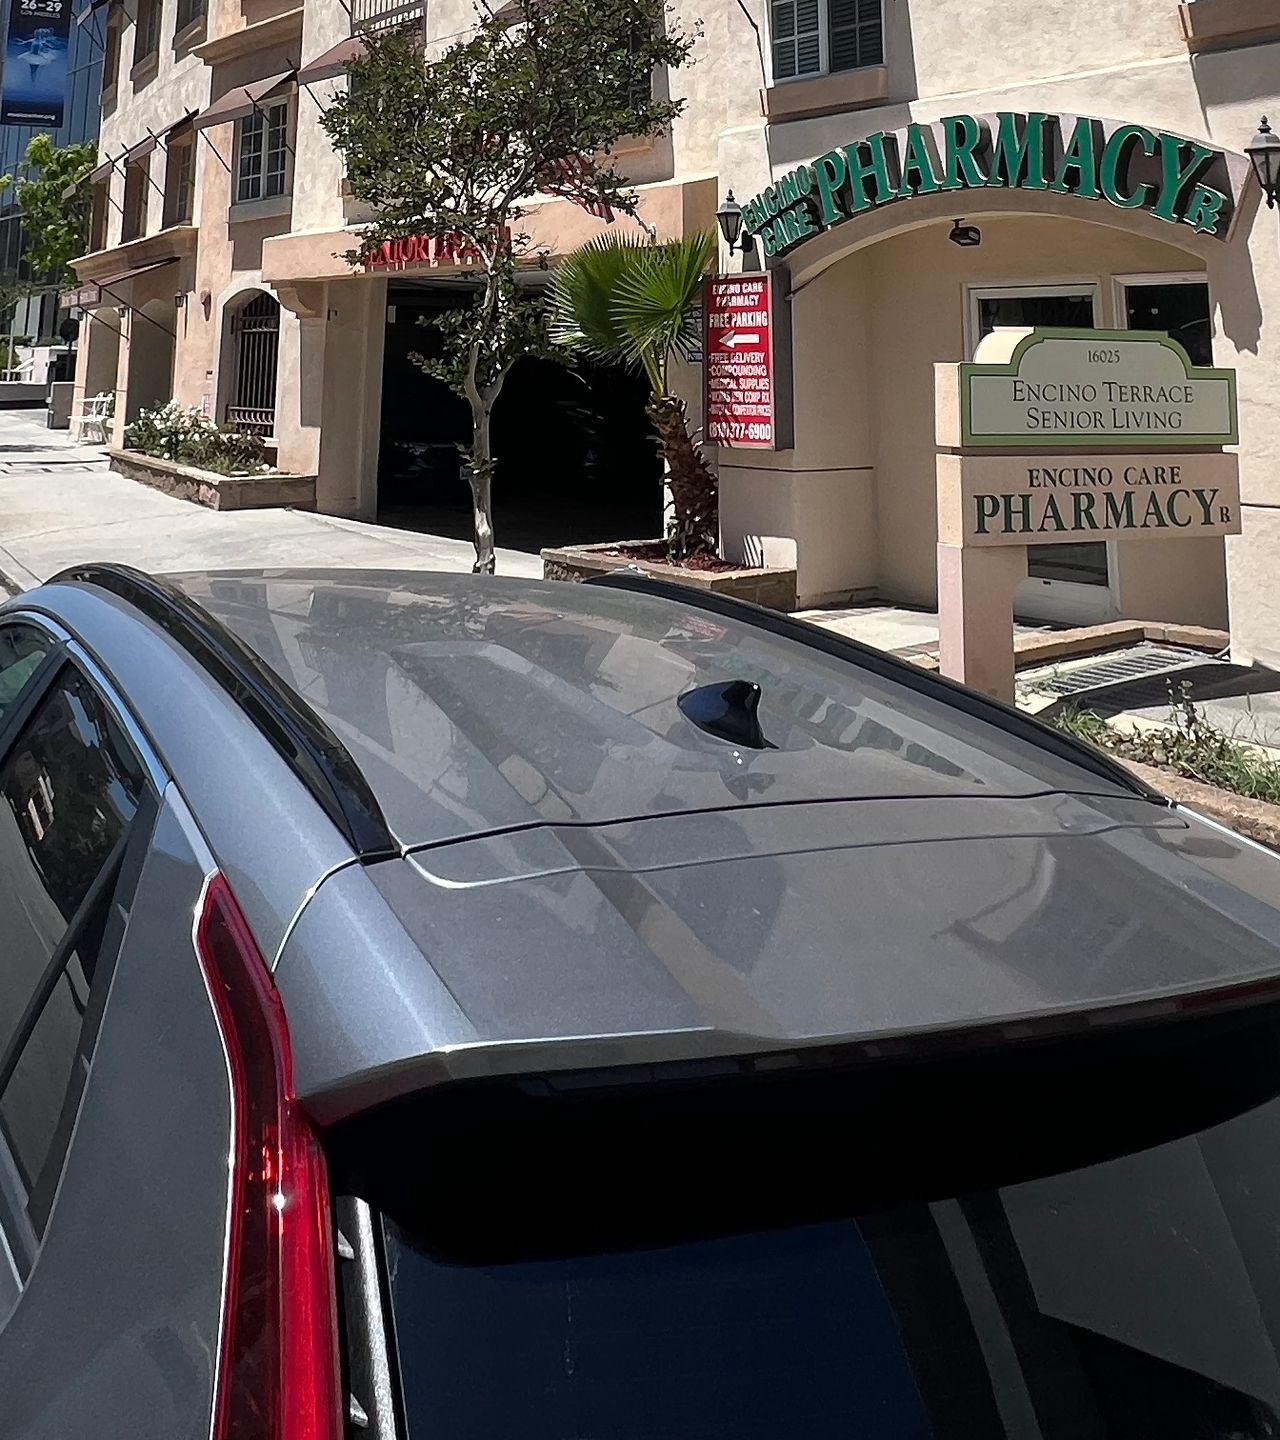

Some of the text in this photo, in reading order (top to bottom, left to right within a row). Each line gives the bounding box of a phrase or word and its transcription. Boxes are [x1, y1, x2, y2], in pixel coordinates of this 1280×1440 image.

[21, 0, 63, 12] 26-29
[811, 111, 1214, 226] PHARMACY
[740, 165, 812, 236] ENCINO
[761, 201, 815, 257] CARE
[742, 281, 763, 294] CARE
[716, 294, 760, 307] PHARMACY
[709, 311, 768, 328] FREE PARKING
[730, 351, 765, 364] DELIVERY
[1088, 350, 1120, 363] 16025
[739, 378, 770, 390] SUPPLIES
[1012, 380, 1195, 403] ENCINO TERRACE
[1026, 407, 1182, 429] SENIOR LIVING
[1027, 466, 1182, 488] ENCINO CARE
[973, 489, 1219, 534] PHARMACY
